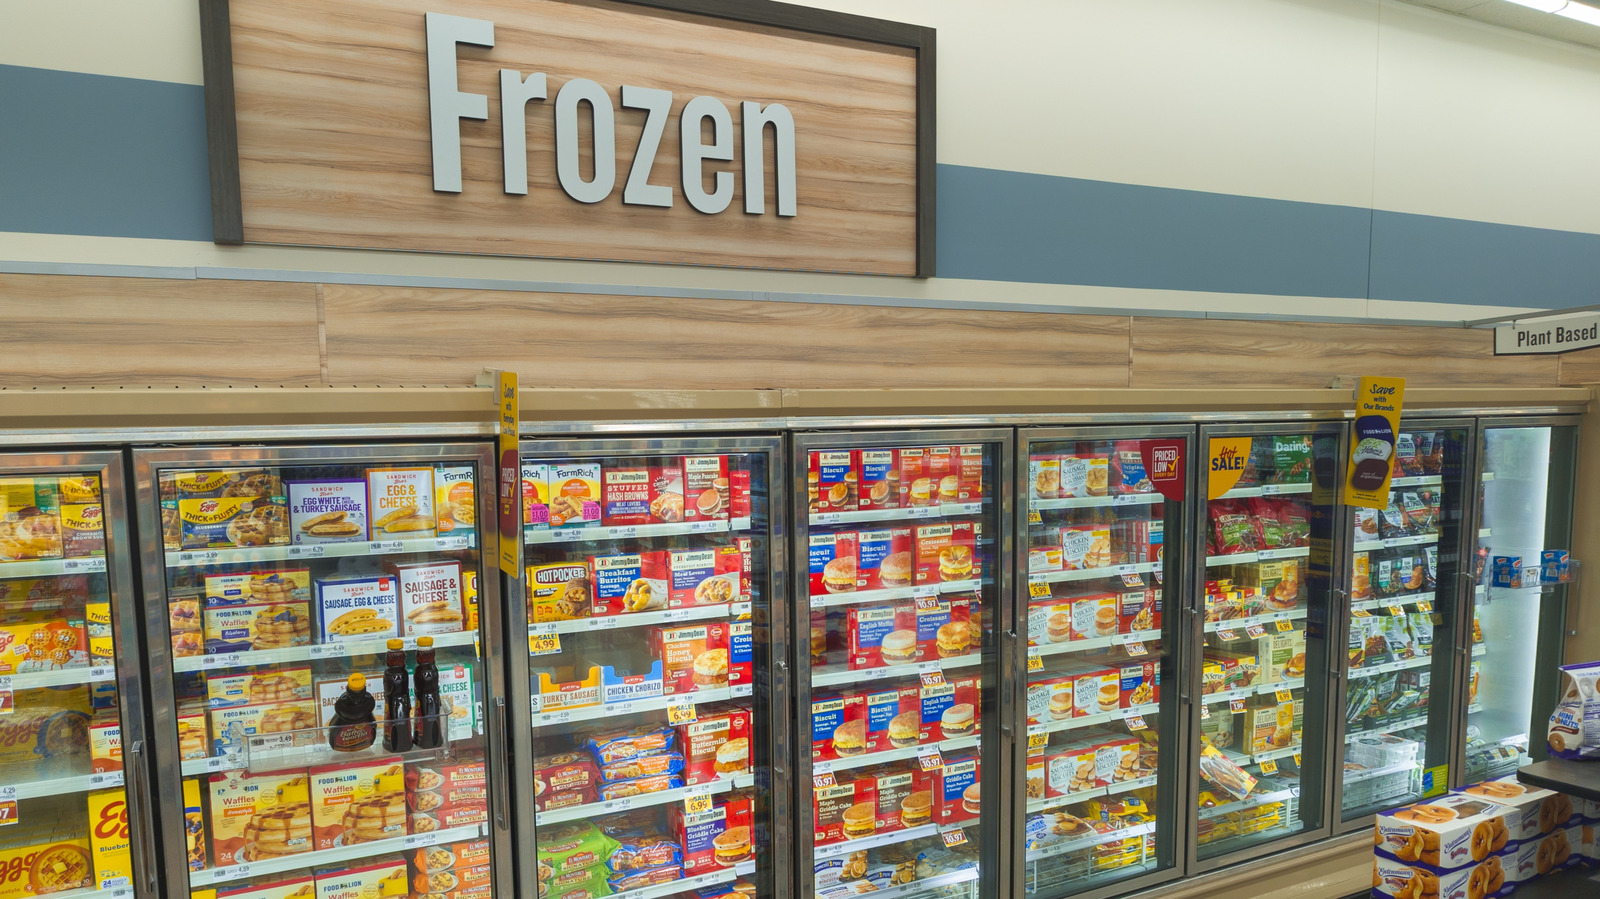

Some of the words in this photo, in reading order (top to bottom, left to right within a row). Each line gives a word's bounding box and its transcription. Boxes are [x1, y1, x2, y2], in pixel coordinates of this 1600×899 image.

[425, 12, 797, 217] Frozen
[1518, 331, 1551, 347] Plant
[1557, 323, 1597, 343] Based
[1370, 384, 1395, 395] Save
[503, 413, 514, 426] Everyday
[1276, 442, 1309, 452] Daring.
[1155, 451, 1175, 460] PRICED
[1220, 447, 1237, 458] Hot
[1155, 462, 1167, 472] LOW
[1212, 457, 1244, 471] SALE!
[502, 468, 515, 482] PRICED
[179, 481, 202, 490] THICK
[206, 474, 229, 490] FLUFFY
[387, 486, 405, 496] EGG
[408, 485, 417, 495] &
[608, 492, 623, 500] HASH
[625, 492, 648, 500] BROWNS
[303, 497, 316, 505] EGG
[318, 497, 341, 505] WHITE
[380, 496, 417, 508] CHEESE
[199, 501, 219, 512] Eggo
[293, 505, 300, 513] &
[185, 512, 208, 522] THICK
[213, 504, 238, 521] FLUFFY
[65, 518, 91, 528] THICK
[921, 538, 948, 546] Croissant
[1064, 537, 1088, 548] CHICKEN
[599, 569, 636, 577] Breakfast
[1262, 568, 1282, 577] DELIGHTS
[405, 581, 446, 593] SAUSAGE
[1034, 587, 1046, 595] 5.99
[325, 599, 353, 609] SAUSAGE,
[356, 598, 366, 606] EGG
[373, 595, 394, 605] CHEESE
[918, 600, 936, 609] 10.97
[1074, 606, 1095, 619] CHICKEN
[919, 615, 947, 623] Croissant
[1077, 615, 1095, 627] BISCUIT
[860, 622, 876, 630] English
[1279, 623, 1290, 631] 6.99
[535, 639, 555, 650] 4.99
[1273, 640, 1292, 648] DELIGHTS
[923, 676, 941, 685] 10.97
[607, 686, 633, 697] CHICKEN
[635, 682, 661, 693] CHORIZO
[1076, 683, 1098, 695] SAUSAGE
[543, 693, 568, 704] TURKEY
[570, 689, 598, 700] SAUSAGE
[923, 698, 938, 706] English
[938, 695, 953, 703] Muffin
[1079, 692, 1098, 704] BISCUIT
[1279, 692, 1290, 700] 6.99
[1232, 702, 1243, 710] 1.99
[674, 711, 691, 720] 6.99
[1257, 713, 1276, 723] DELIGHTS
[1558, 712, 1573, 721] MINI
[691, 734, 713, 743] Chicken
[691, 737, 727, 749] Buttermilk
[1032, 737, 1045, 745] 5.99
[692, 747, 716, 756] Biscuit
[921, 759, 940, 768] 10.97
[1263, 764, 1274, 772] 6.99
[813, 777, 833, 787] 10.97
[946, 775, 962, 783] Griddle
[694, 794, 710, 802] SALE!
[691, 801, 707, 810] 6.99
[819, 804, 839, 813] Griddle
[448, 816, 486, 824] SIGNATURE
[687, 824, 715, 833] Blueberry
[1379, 826, 1414, 835] Entenmann's
[688, 831, 709, 839] Griddle
[945, 834, 964, 843] 10.97
[1444, 827, 1472, 854] Entenmann's
[1378, 868, 1413, 878] Entenmann's
